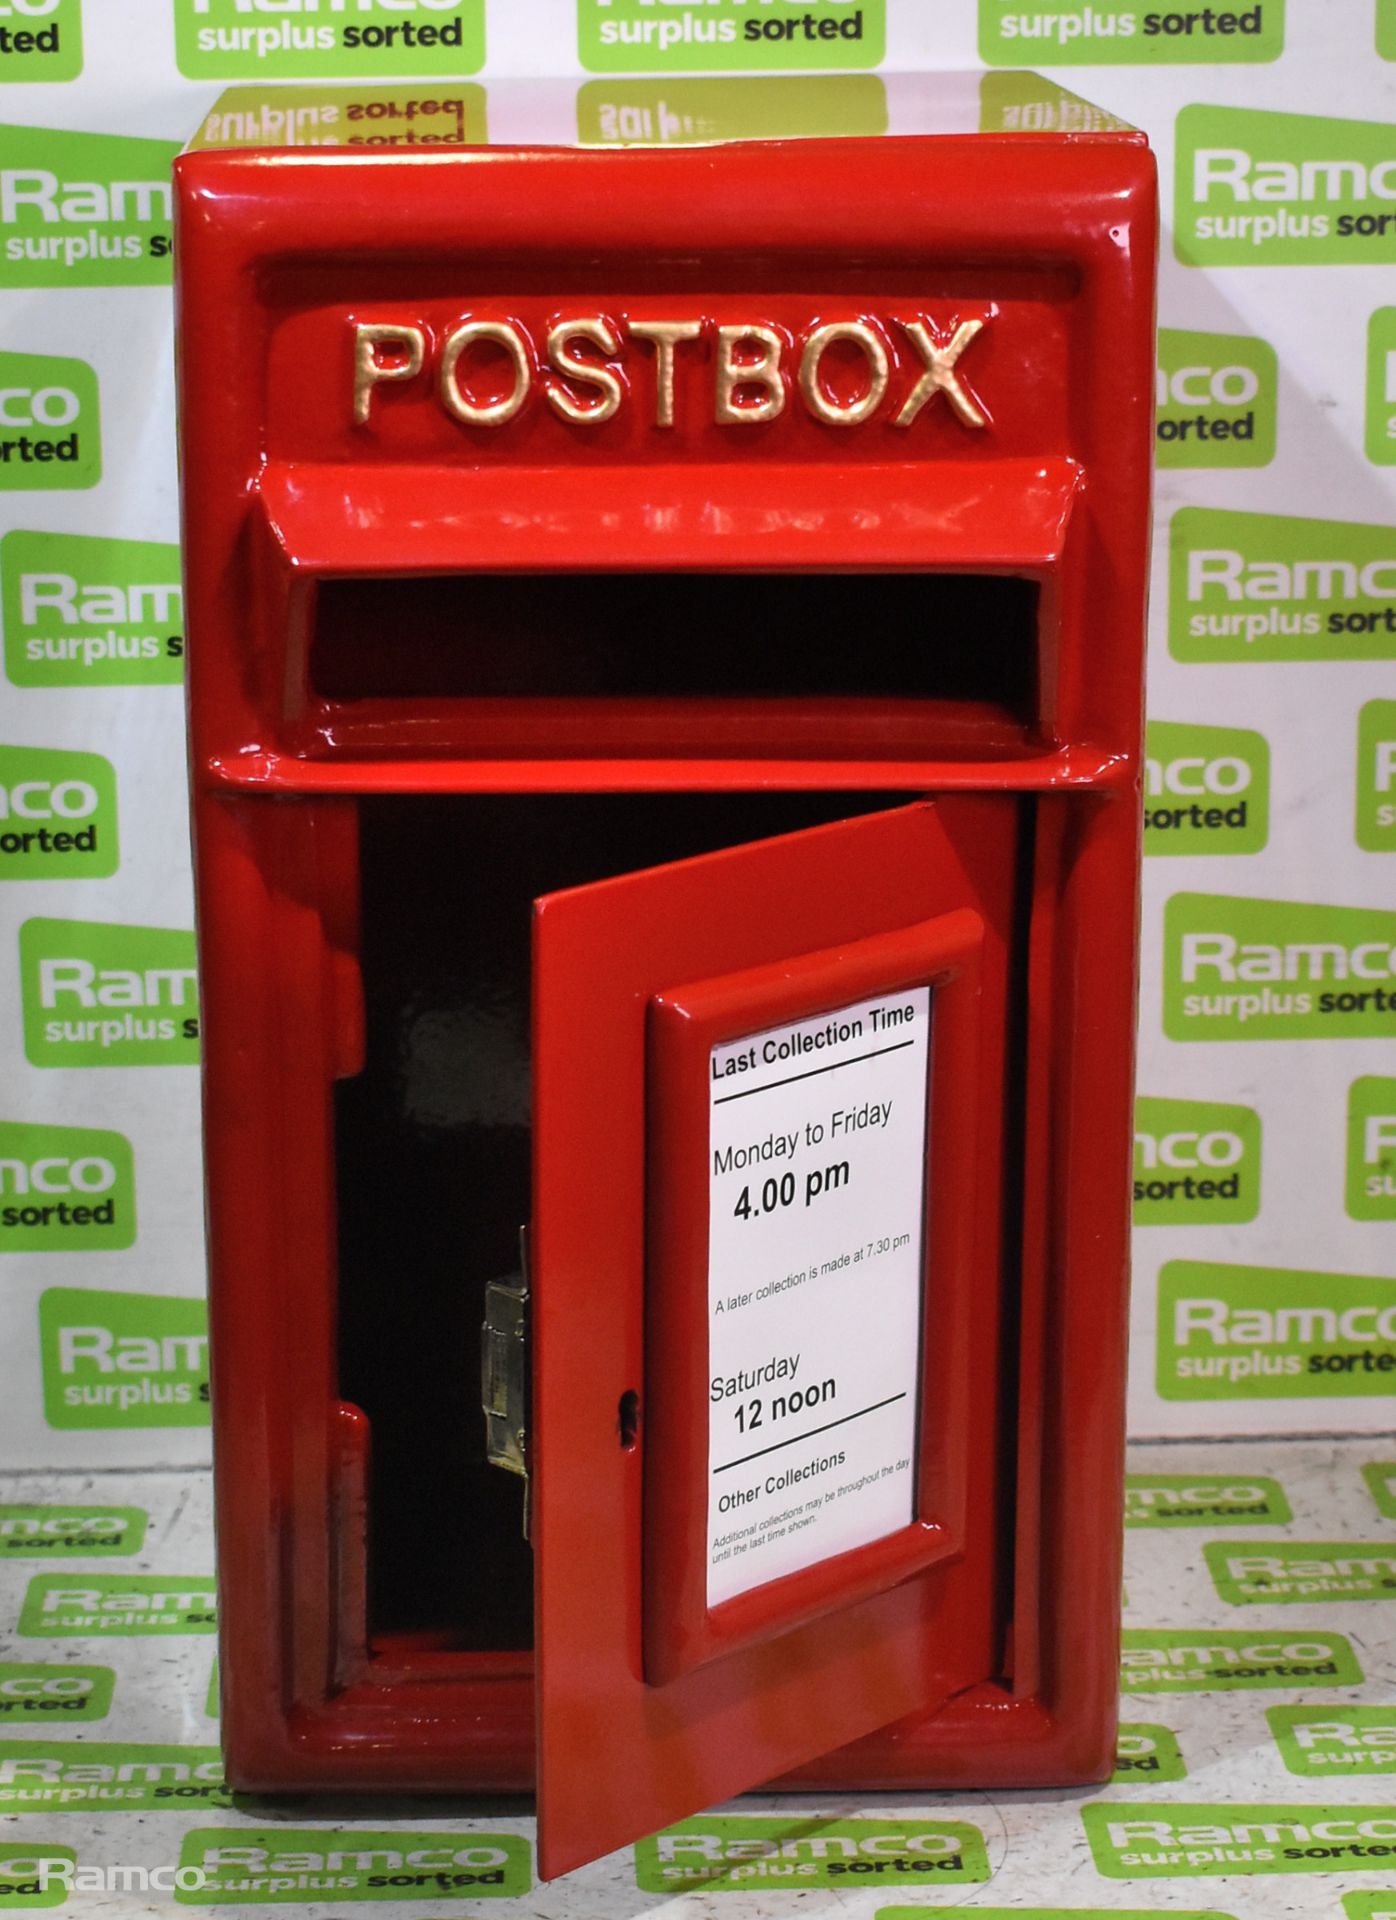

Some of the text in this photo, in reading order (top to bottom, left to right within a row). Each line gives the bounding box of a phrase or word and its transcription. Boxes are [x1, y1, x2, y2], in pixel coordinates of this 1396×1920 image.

[198, 17, 462, 58] surplus sorted
[600, 10, 863, 50] surplus sorted
[1000, 5, 1262, 45] surplus sorted
[1195, 208, 1396, 246] surplus sor
[7, 230, 142, 266] surplus
[354, 320, 986, 428] POSTBOX
[0, 433, 79, 462] rted
[1188, 607, 1320, 643] surplus
[26, 630, 160, 667] surplus
[0, 780, 98, 820] co
[1181, 933, 1396, 983] Ramc
[1184, 988, 1312, 1023] surplus
[46, 1013, 176, 1048] surplus
[712, 1004, 915, 1080] Last Collection Time
[714, 1100, 893, 1176] Monday to Friday
[733, 1160, 850, 1221] 4.00 pm
[2, 1199, 115, 1227] sorted
[715, 1233, 911, 1315] A later collection is made at 7.30 pm
[710, 1353, 800, 1403] Saturday
[1176, 1350, 1301, 1382] surplus
[64, 1378, 192, 1411] surplus
[734, 1378, 836, 1434] 12 noon
[718, 1450, 846, 1514] Other Collections
[713, 1457, 911, 1551] Additional collections may be throughout the day
[712, 1513, 817, 1565] until the last time shown.
[1239, 1578, 1373, 1594] surplus
[41, 1611, 178, 1628] surplus
[1213, 1661, 1338, 1678] sorted
[0, 1784, 146, 1803] surplus
[203, 1847, 509, 1873] Ramco
[657, 1834, 962, 1862] Ramco
[1120, 1844, 1396, 1866] surplus sorte
[203, 1870, 504, 1894] surplus sorted
[662, 1855, 964, 1881] surplus sorted
